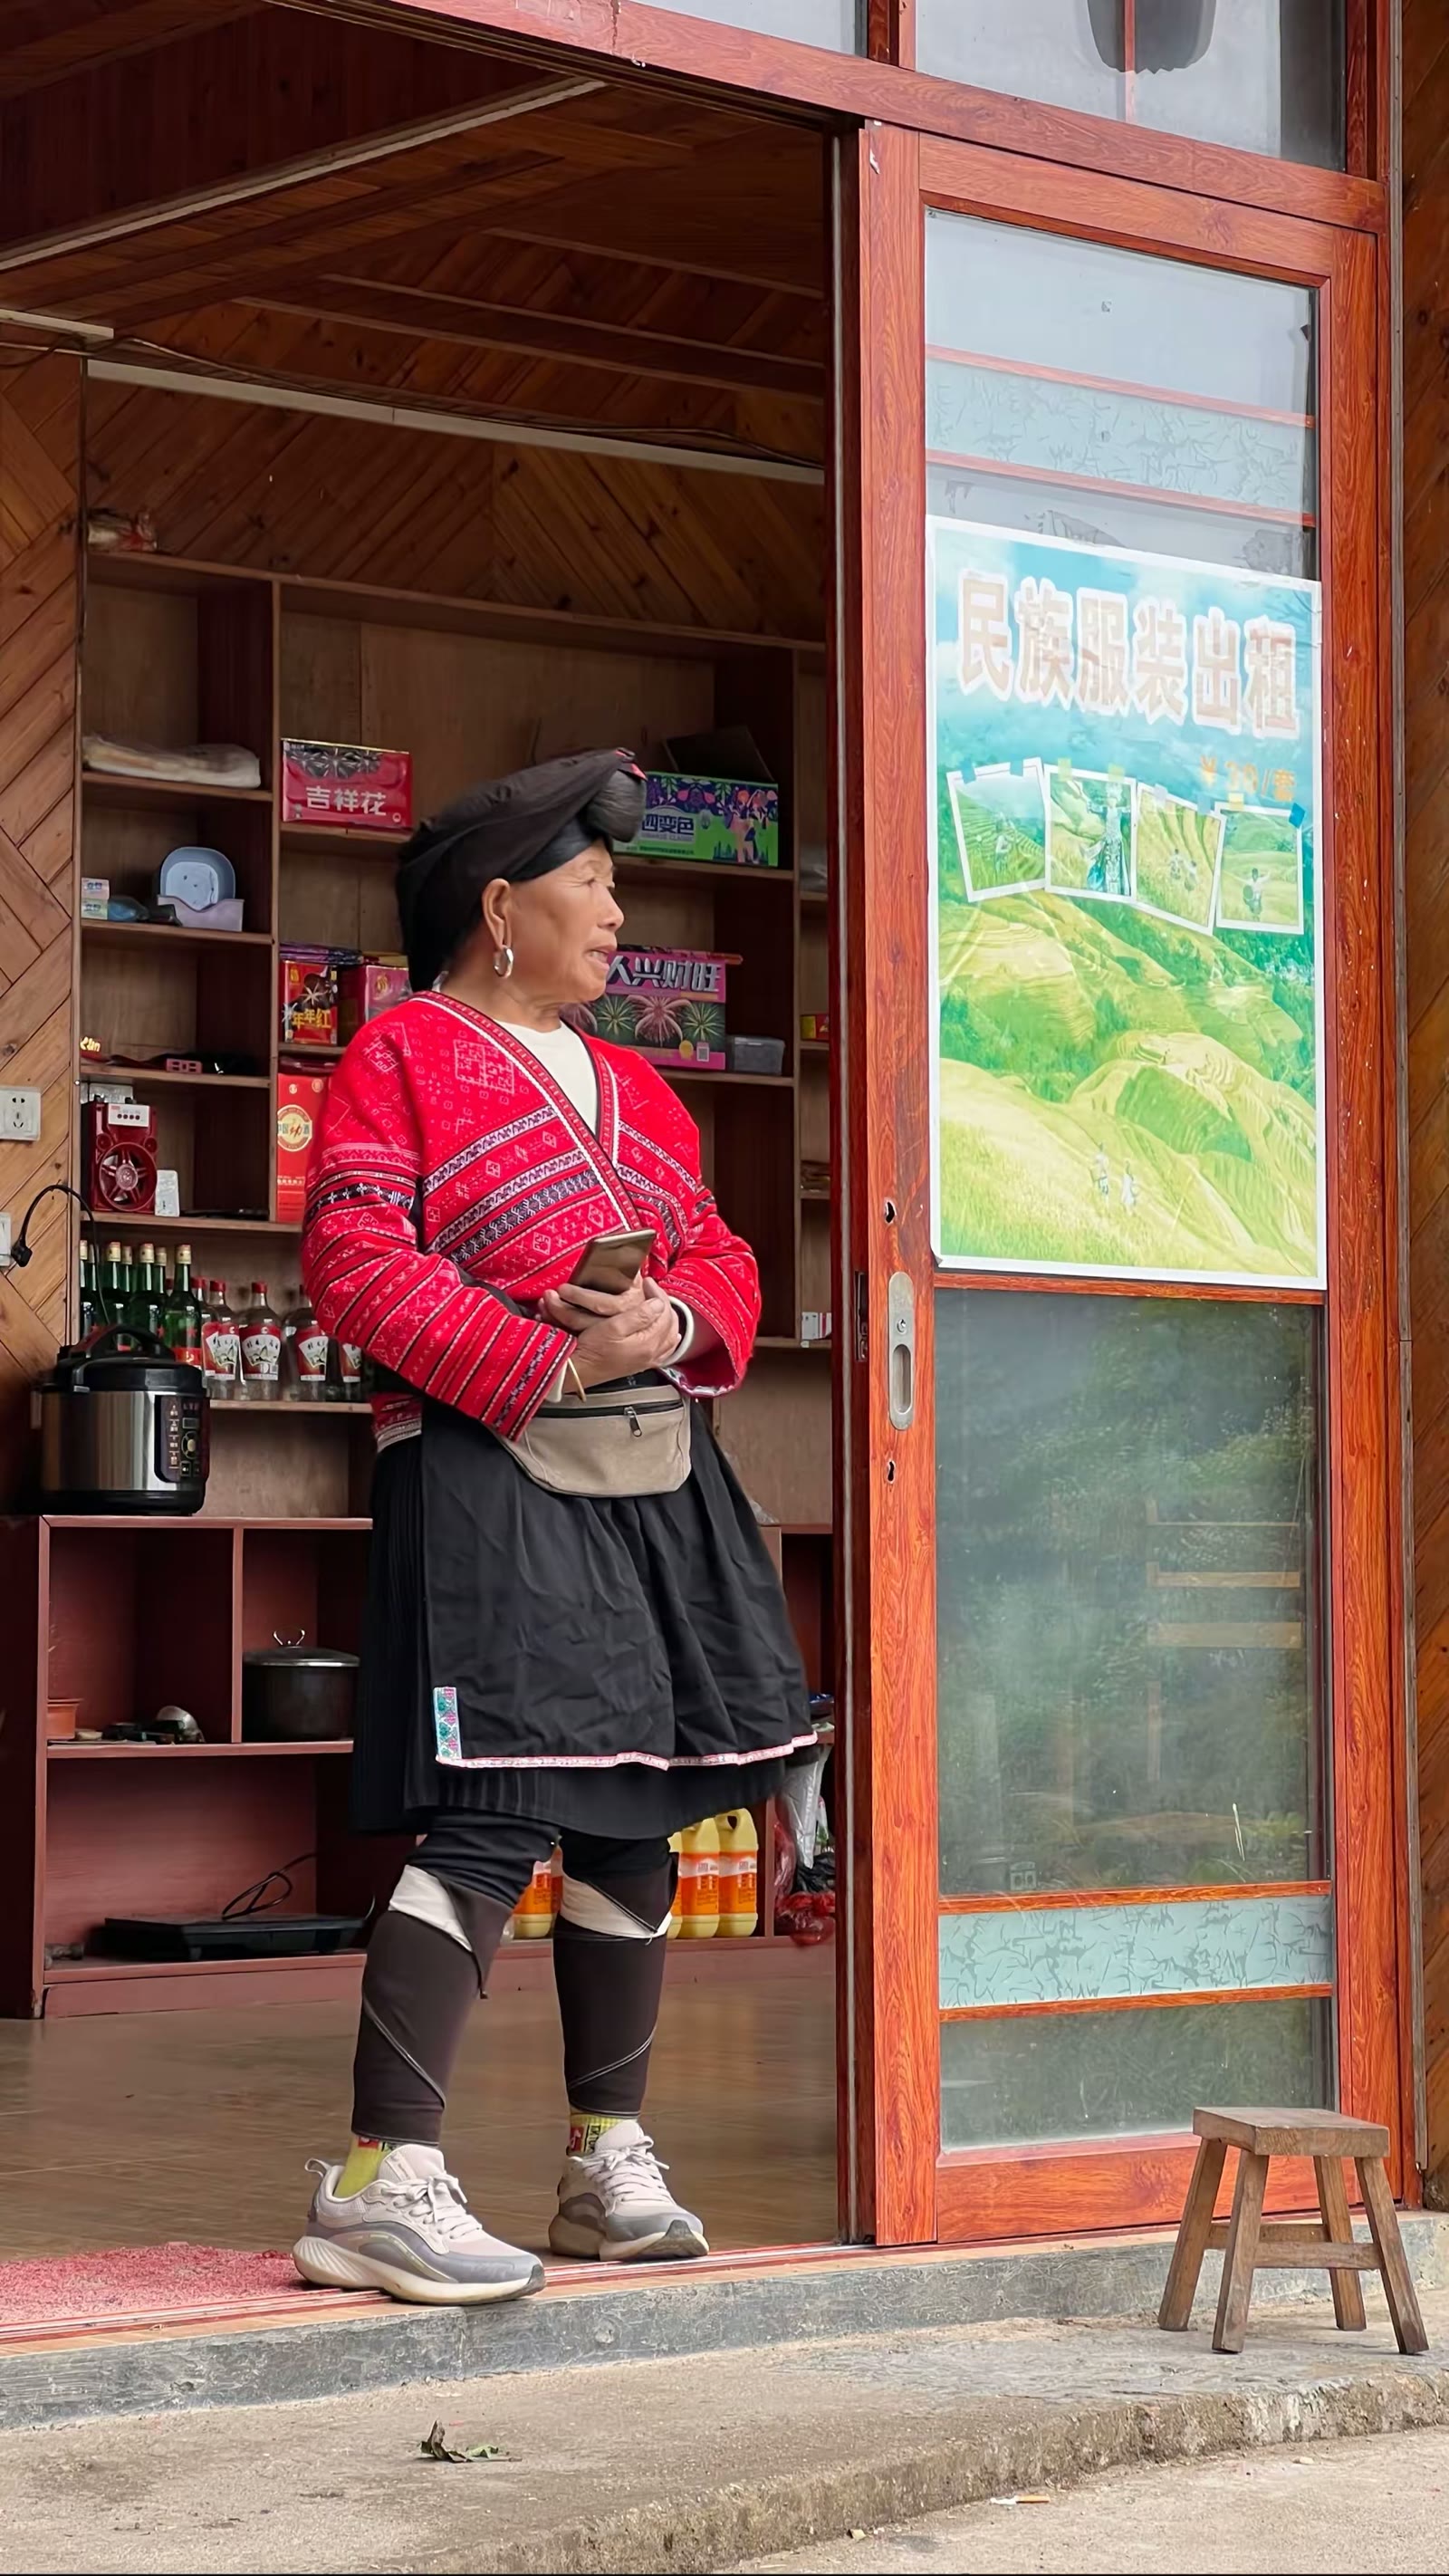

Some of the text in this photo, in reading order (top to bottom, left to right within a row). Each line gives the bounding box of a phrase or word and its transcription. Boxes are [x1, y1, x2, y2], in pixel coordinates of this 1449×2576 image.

[960, 574, 1299, 737] 民族服装出租
[305, 785, 388, 816] 吉祥花
[641, 813, 695, 835] 四变色
[606, 954, 720, 993] 人兴财旺
[292, 1007, 331, 1031] 年年红
